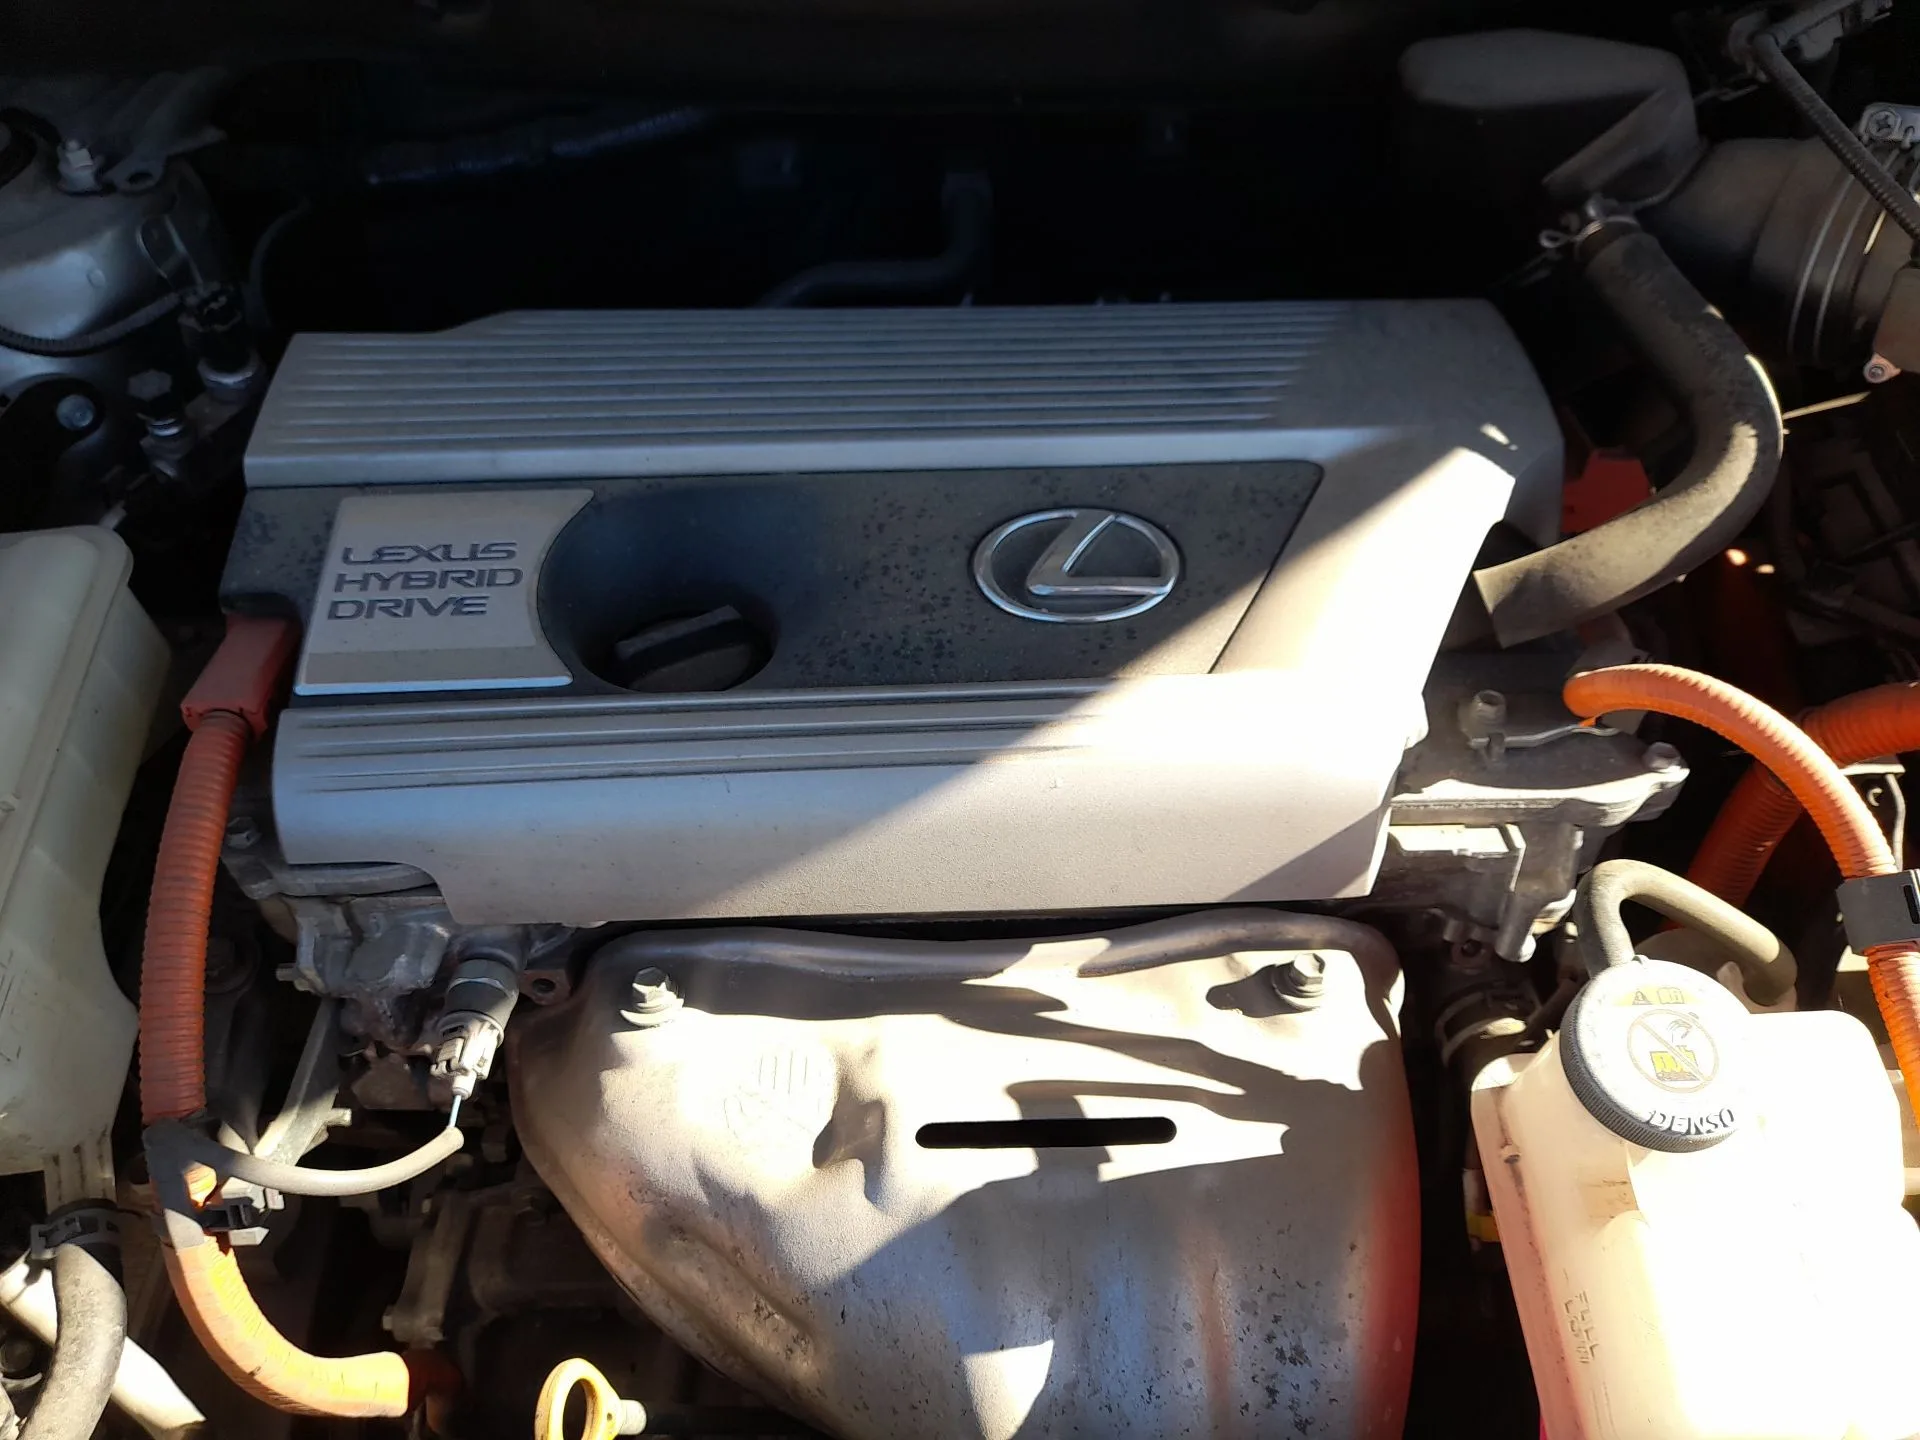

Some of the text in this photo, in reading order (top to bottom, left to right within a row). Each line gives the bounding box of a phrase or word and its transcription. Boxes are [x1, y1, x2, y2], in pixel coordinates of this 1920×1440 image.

[341, 542, 518, 565] LEXUS
[334, 568, 524, 593] HYBRID
[327, 595, 489, 620] DRIVE
[1647, 1108, 1735, 1136] DENSO
